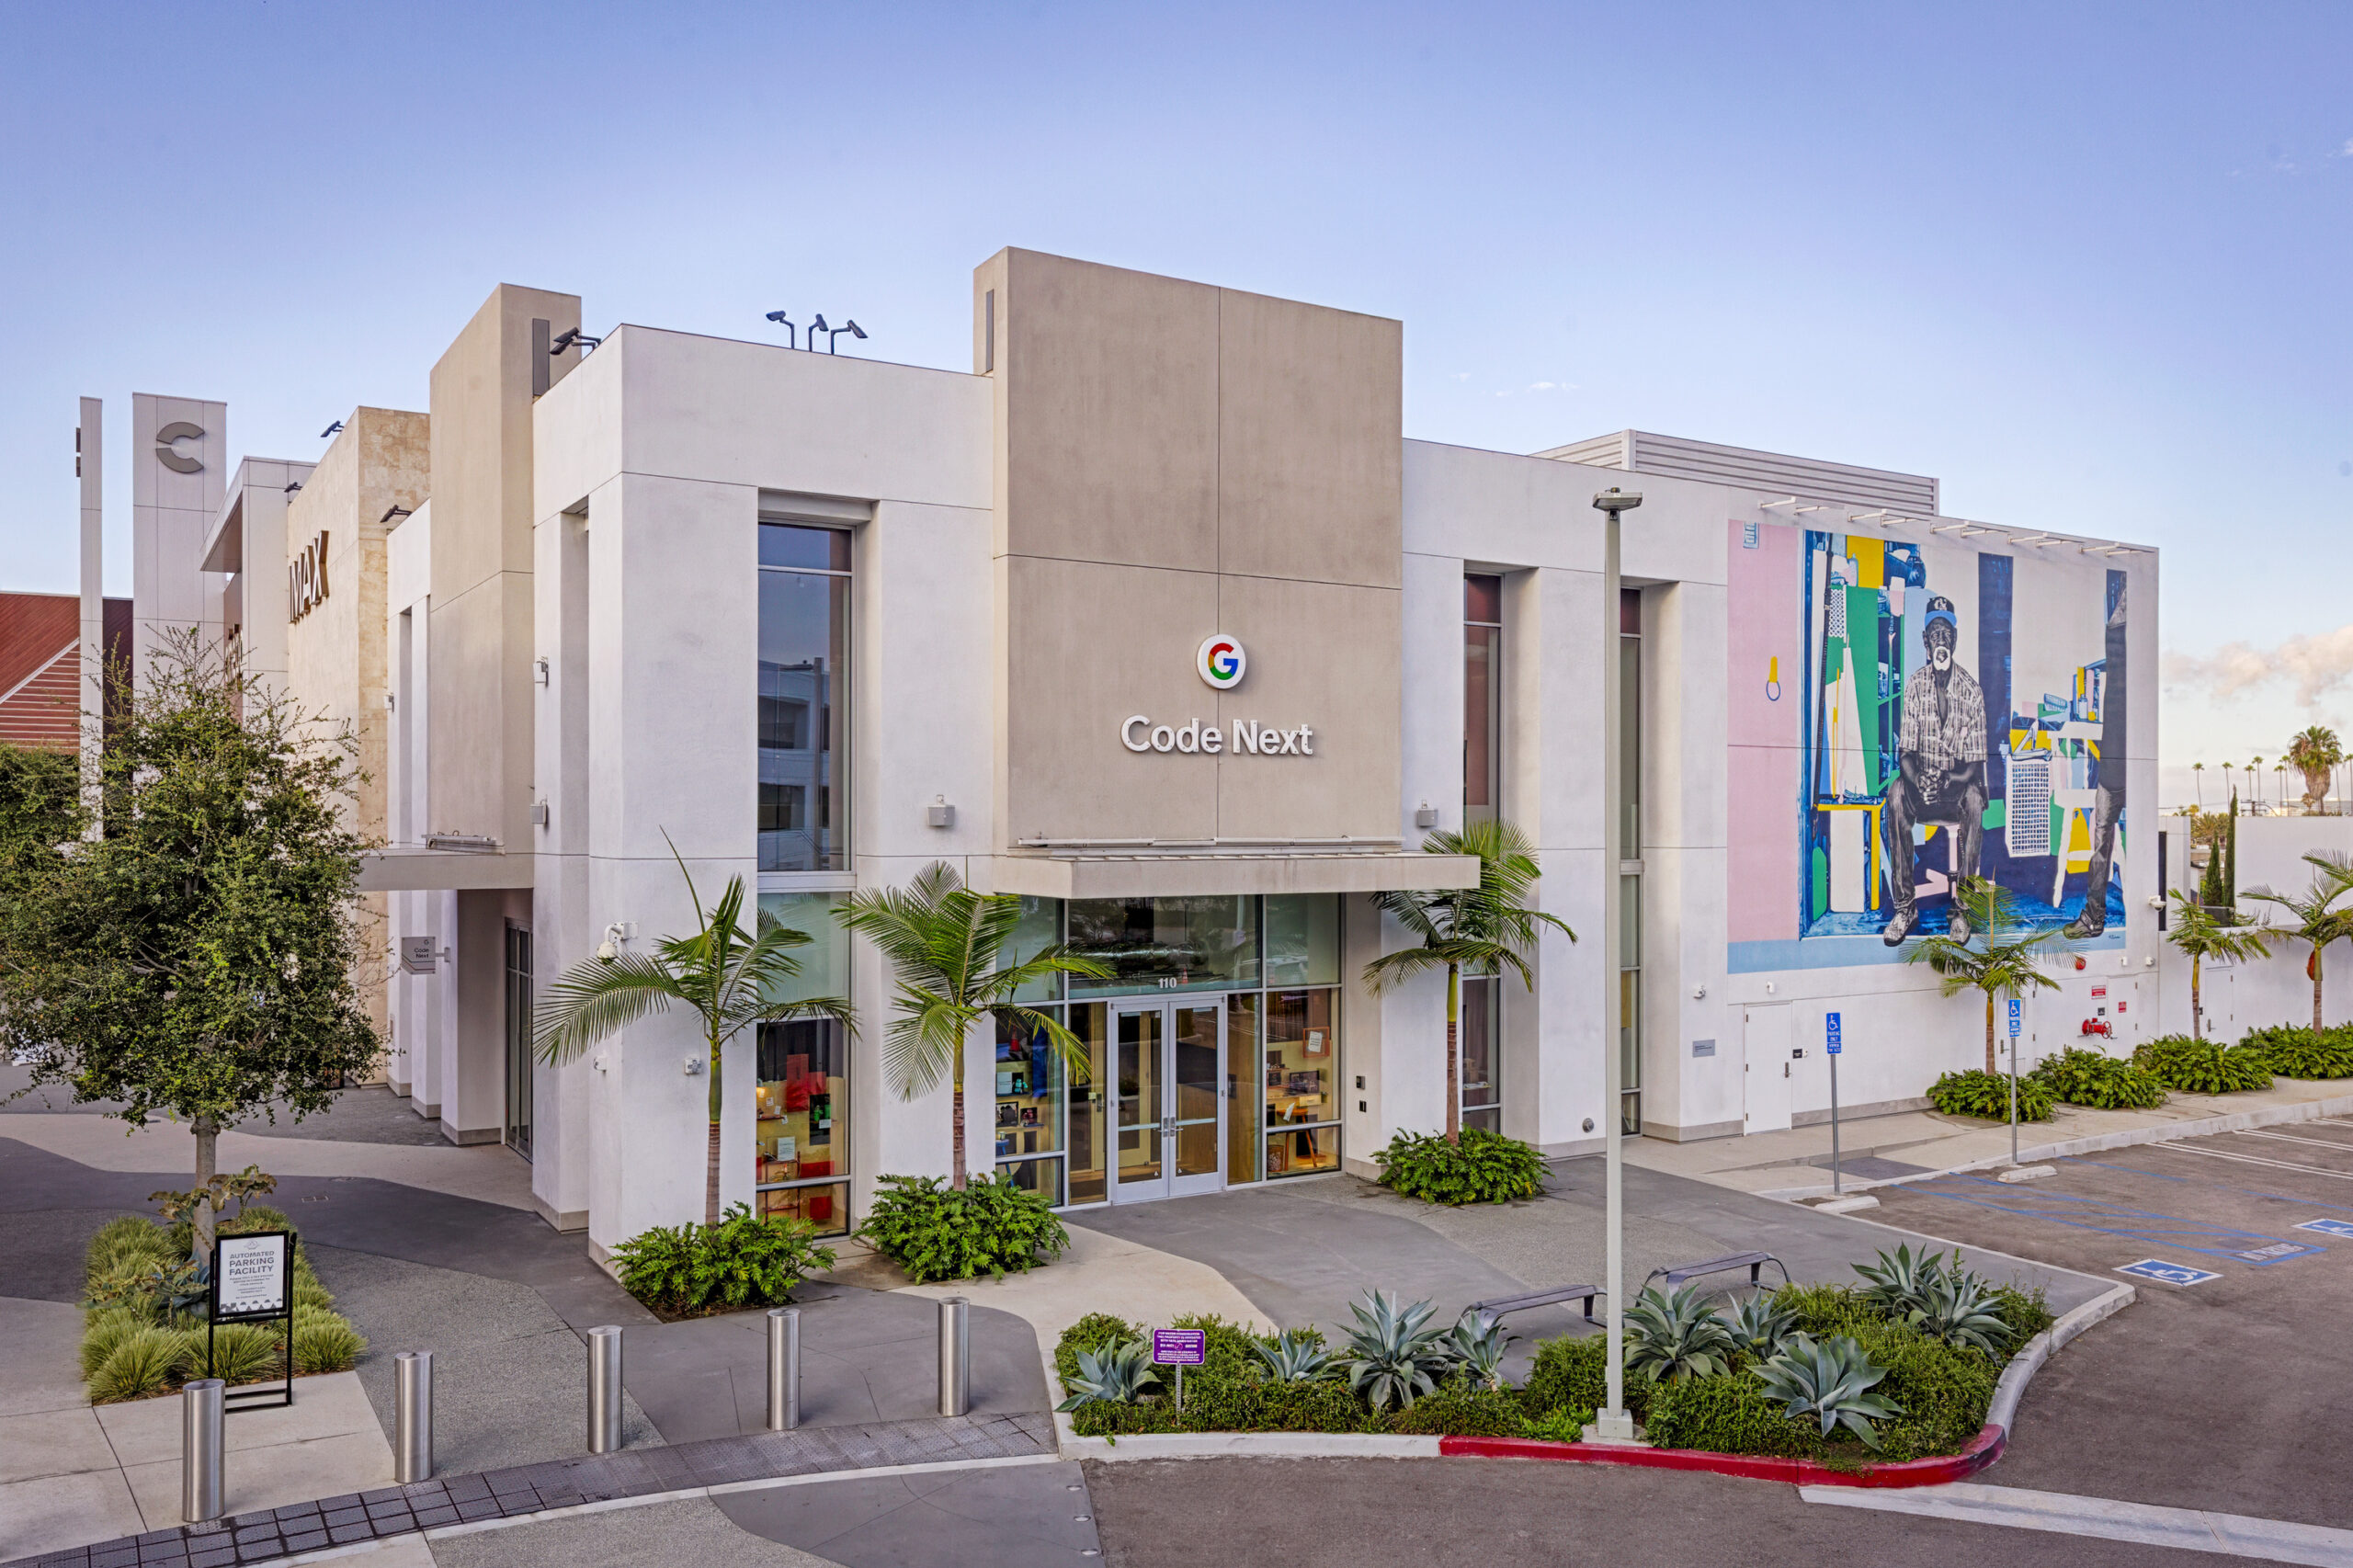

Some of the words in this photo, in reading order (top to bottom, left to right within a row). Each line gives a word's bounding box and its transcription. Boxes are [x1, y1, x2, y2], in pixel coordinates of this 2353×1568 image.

[289, 530, 329, 624] IMAX
[1208, 642, 1238, 680] G
[1120, 714, 1223, 754] Code
[1233, 719, 1313, 755] Next
[1158, 977, 1176, 988] 110
[229, 1251, 275, 1259] AUTOMATED
[229, 1257, 275, 1267] PARKING
[229, 1265, 274, 1276] FACILITY
